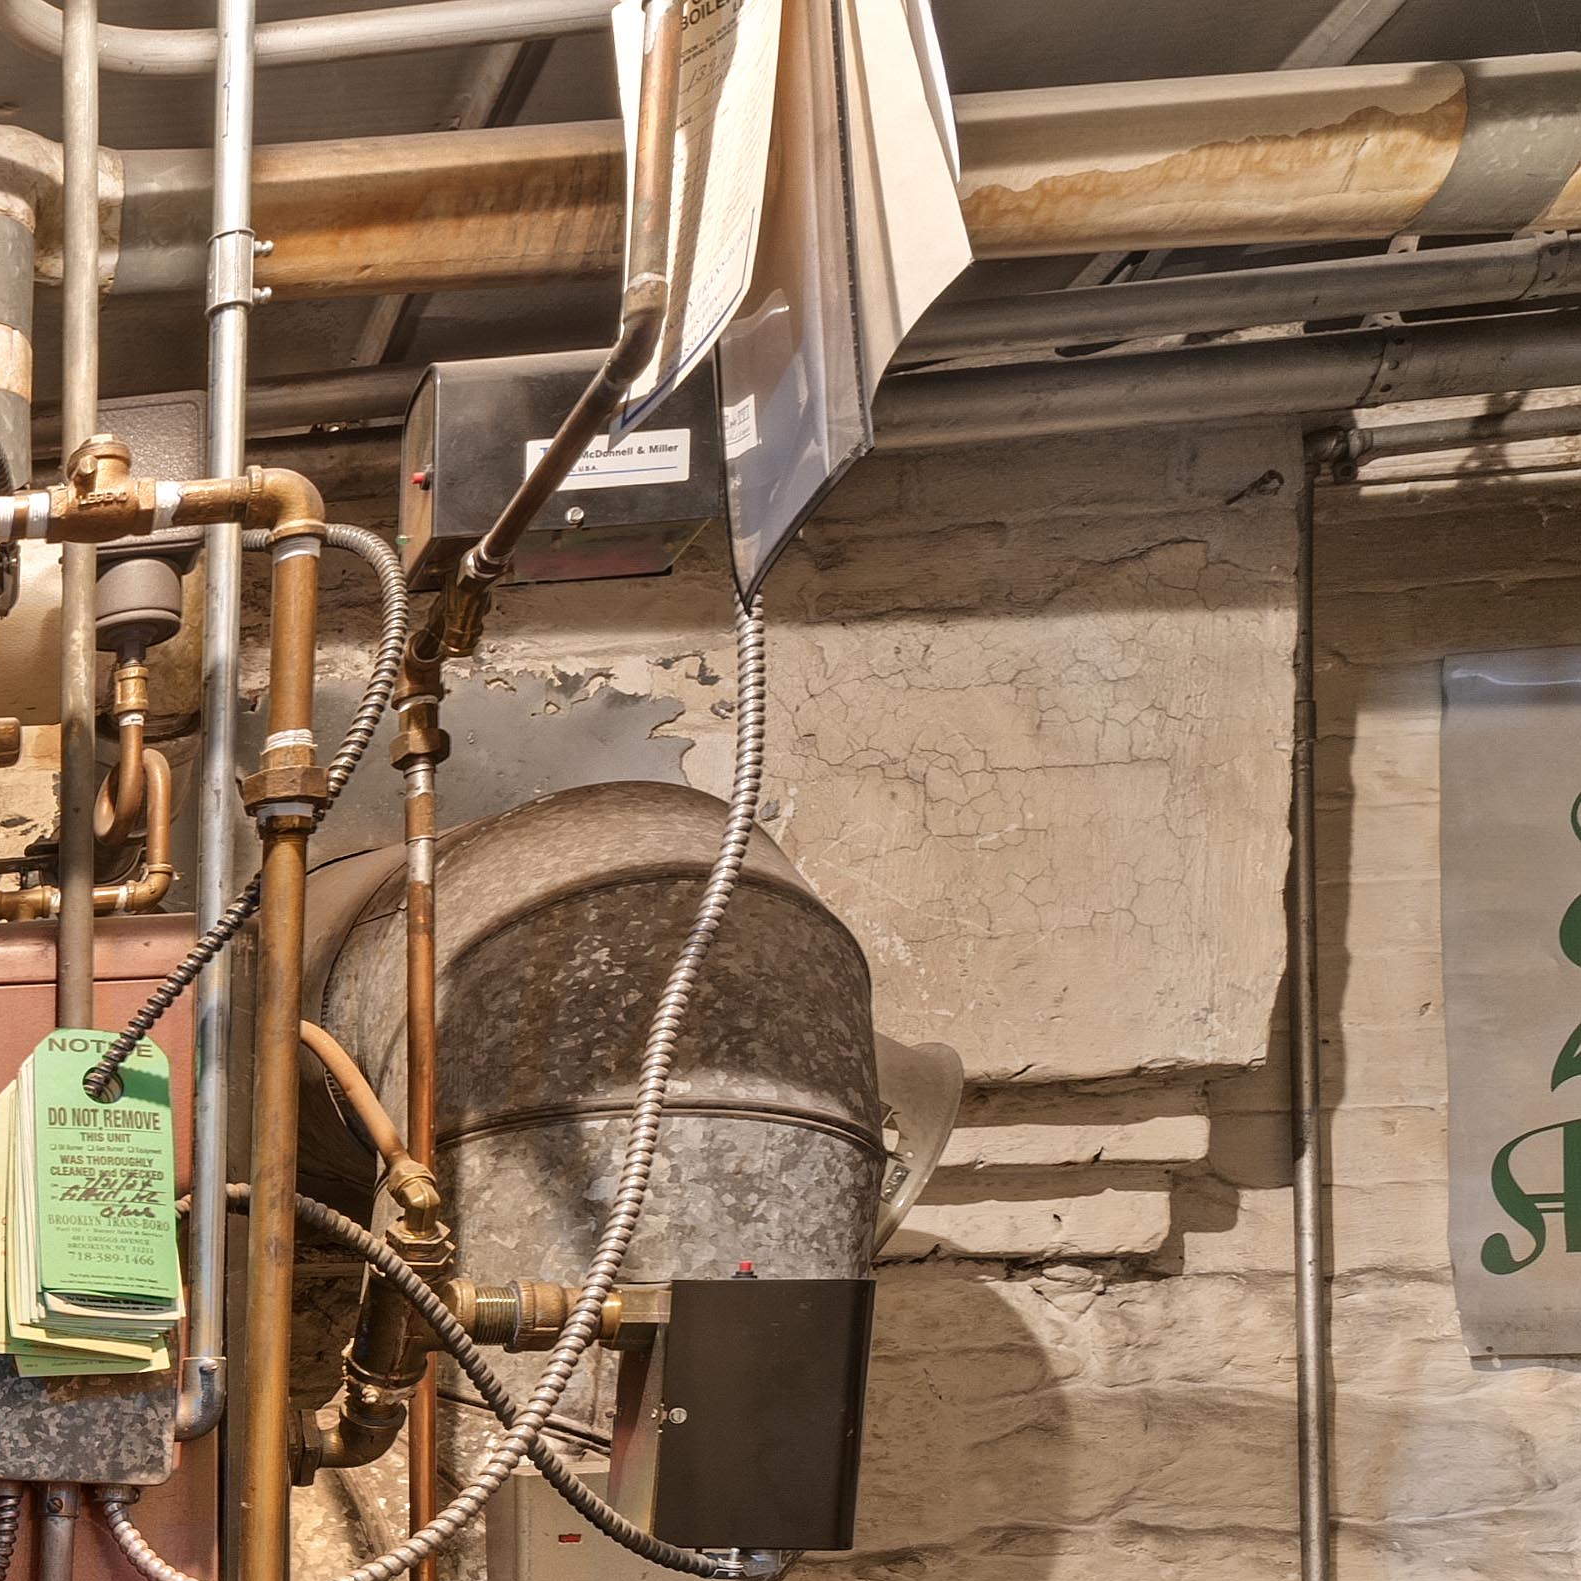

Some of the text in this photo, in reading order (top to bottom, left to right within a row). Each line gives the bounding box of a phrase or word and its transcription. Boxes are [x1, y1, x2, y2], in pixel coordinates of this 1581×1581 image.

[637, 446, 645, 455] &
[649, 444, 679, 454] Miller
[48, 1038, 153, 1058] NOTE
[48, 1107, 161, 1131] DO NOT REMOVE
[80, 1132, 132, 1143] THIS UNIT
[60, 1155, 154, 1167] WAS THOROUGHLY
[50, 1166, 96, 1177] CLEANED
[120, 1168, 164, 1181] CHECKED
[48, 1214, 170, 1231] BROOKLYN TRANS-BORO
[67, 1250, 155, 1266] 718-389-1466
